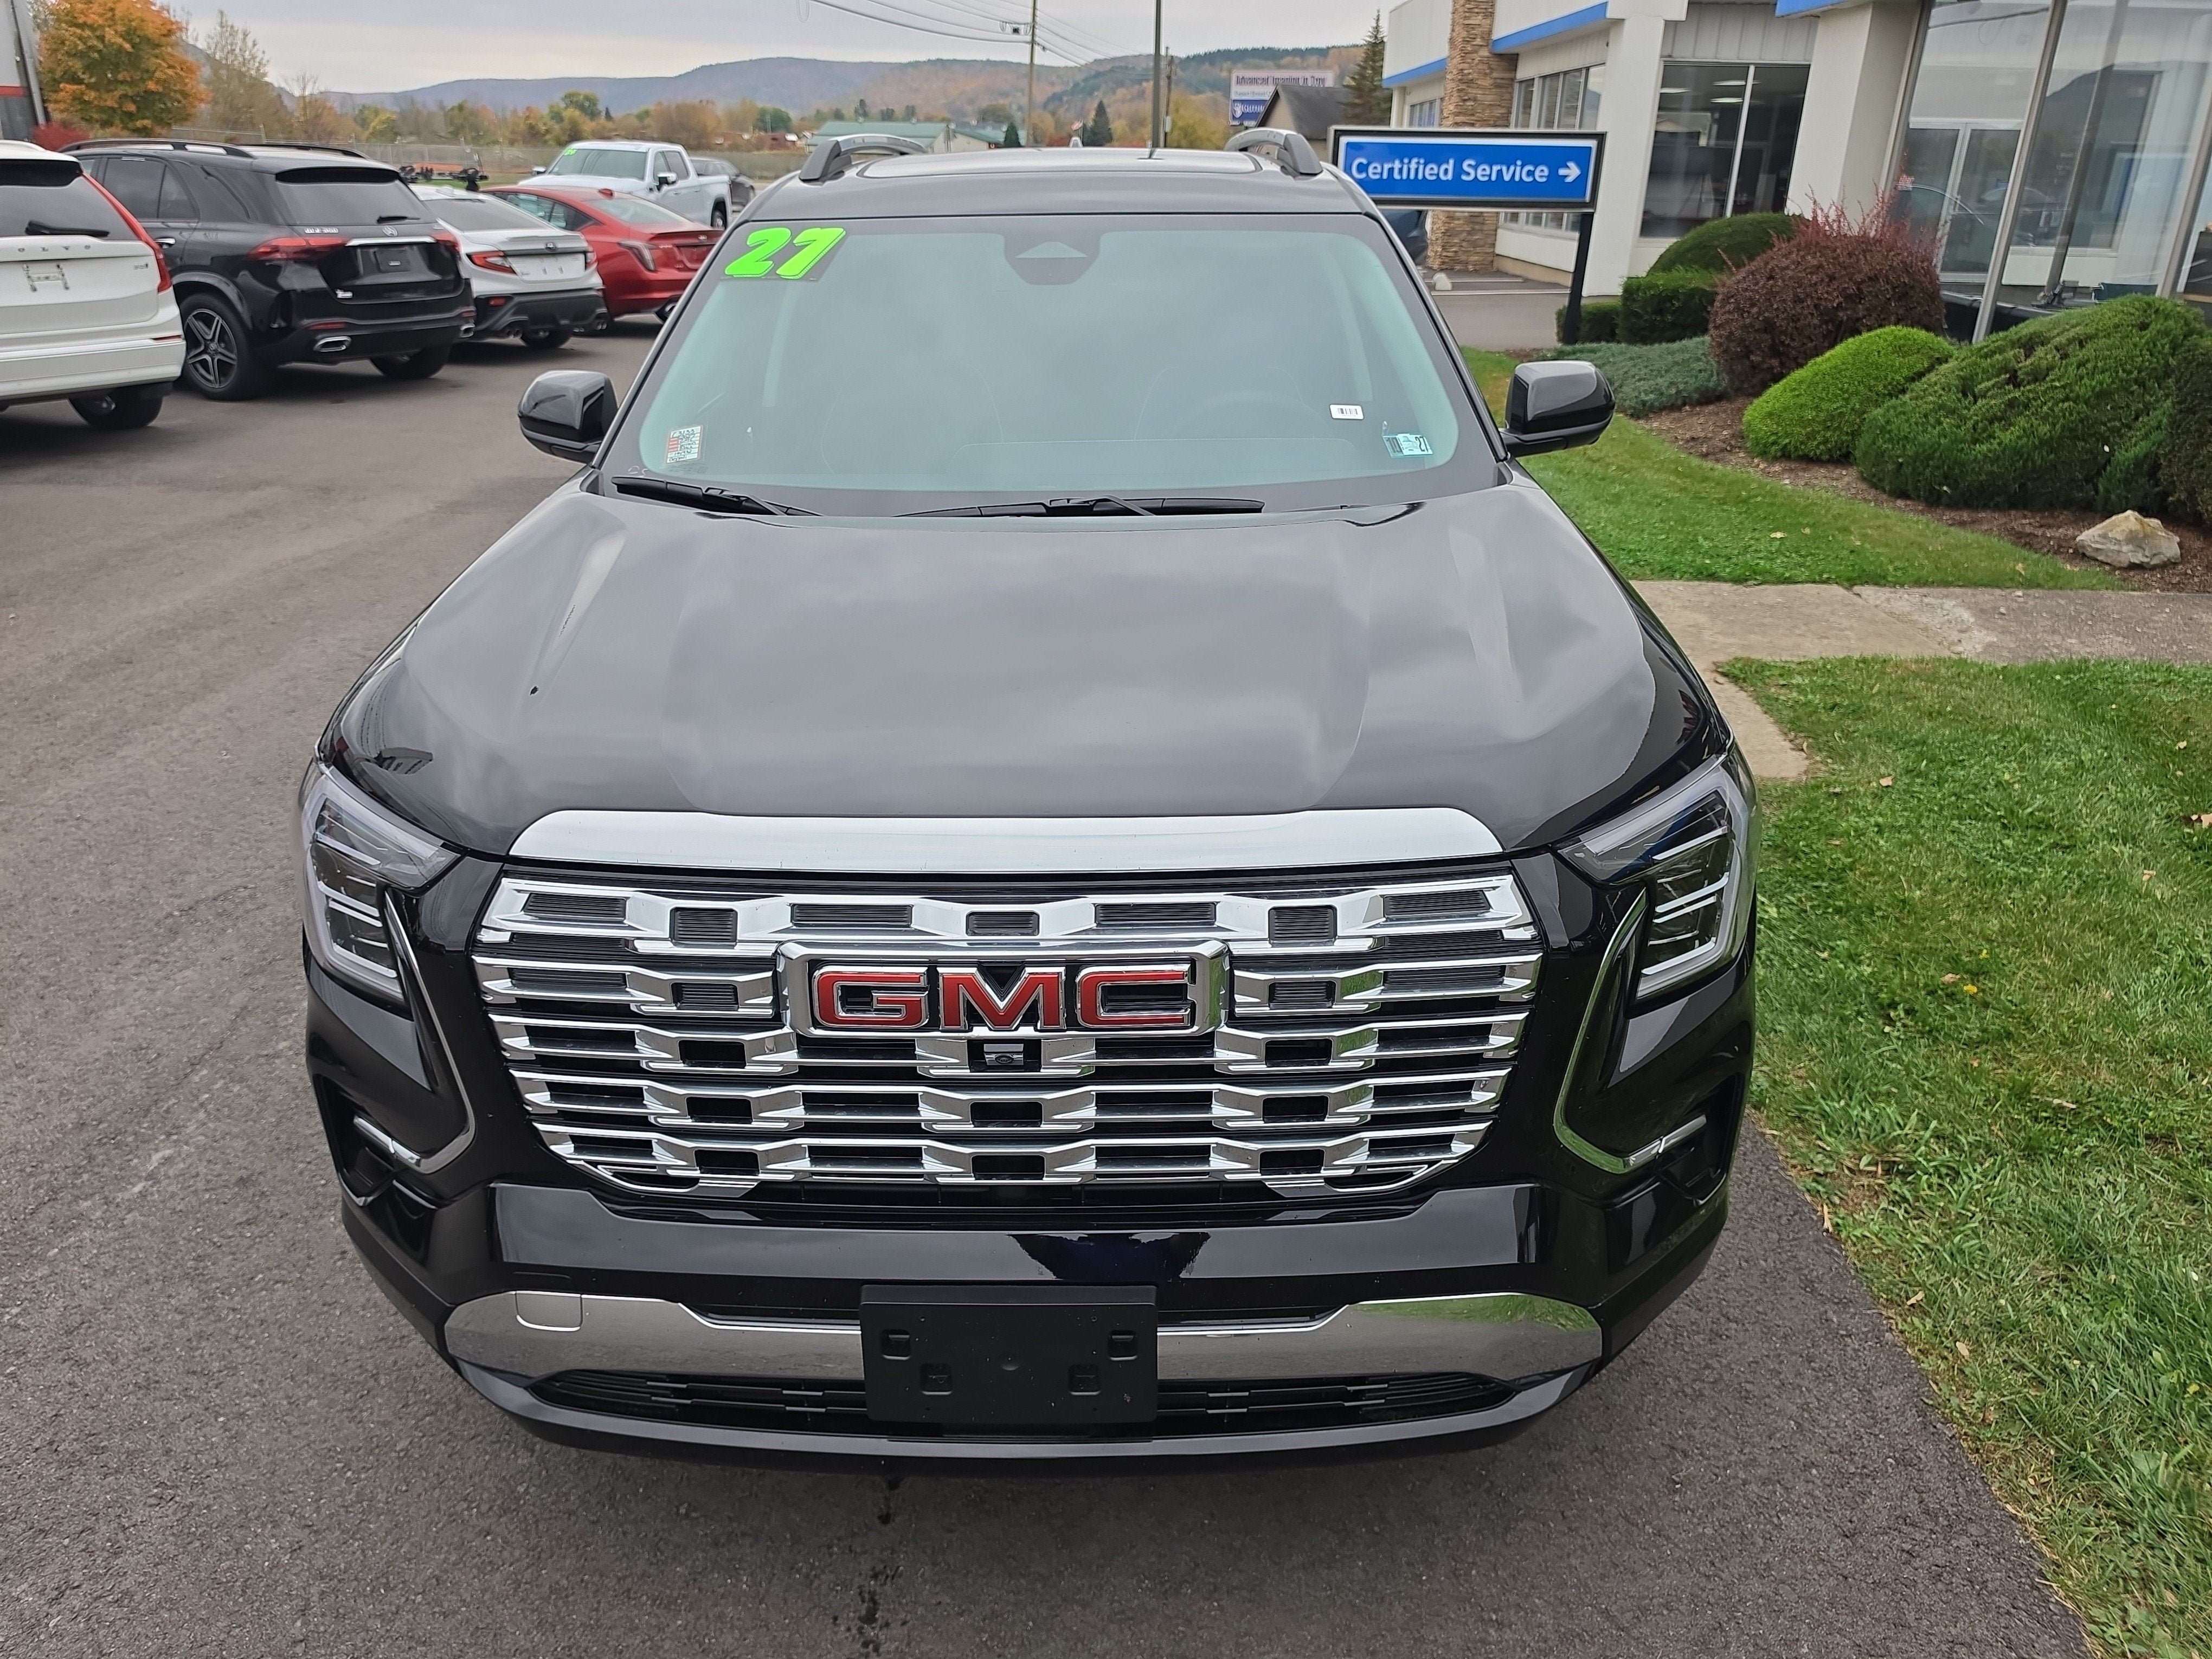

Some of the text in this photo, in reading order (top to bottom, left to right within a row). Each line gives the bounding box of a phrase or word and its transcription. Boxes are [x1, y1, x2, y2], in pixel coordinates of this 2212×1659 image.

[1351, 157, 1549, 183] Certified Service
[724, 227, 846, 280] 27
[813, 963, 1191, 1030] GMC
